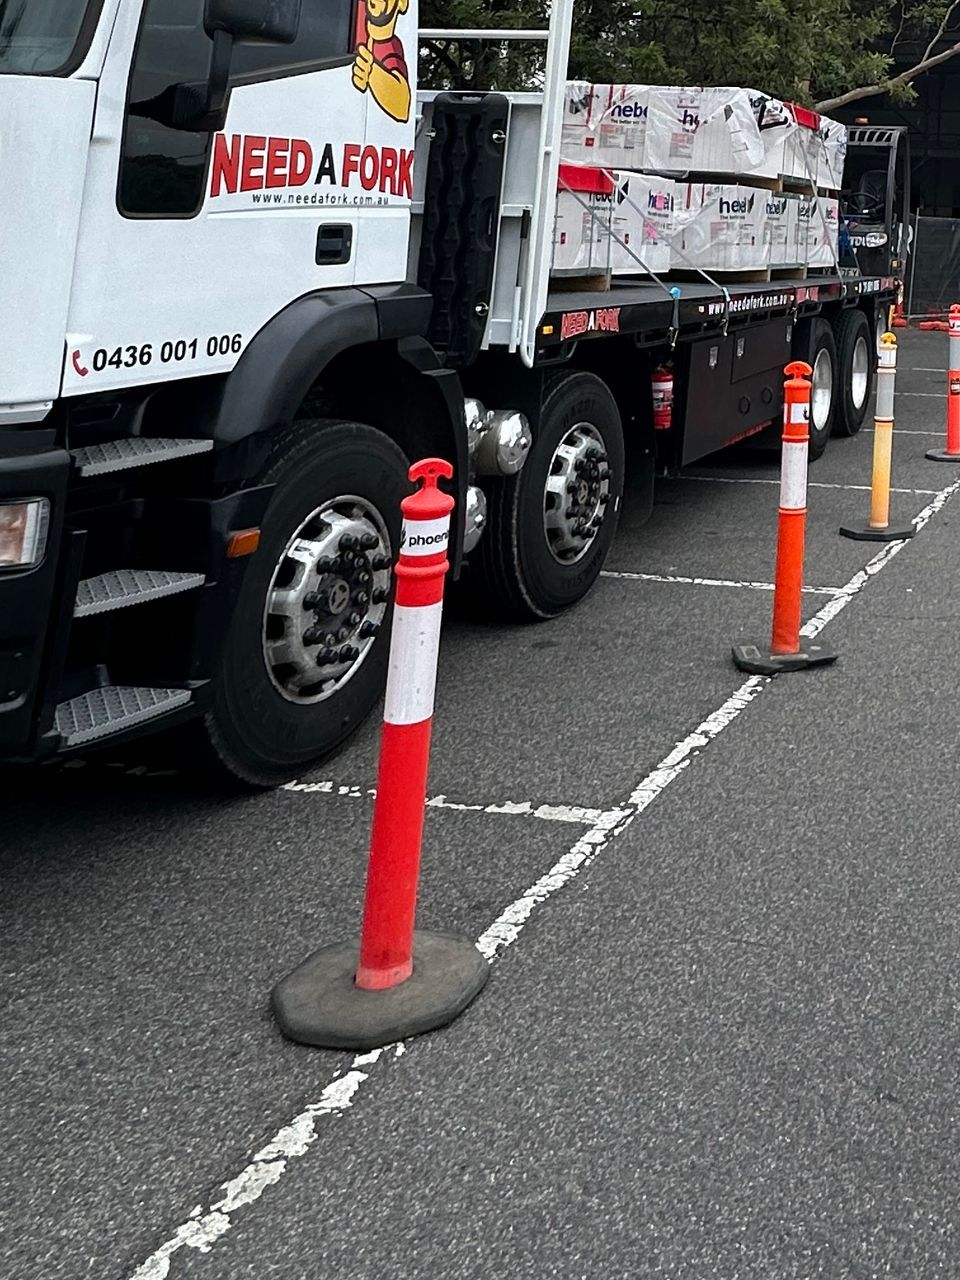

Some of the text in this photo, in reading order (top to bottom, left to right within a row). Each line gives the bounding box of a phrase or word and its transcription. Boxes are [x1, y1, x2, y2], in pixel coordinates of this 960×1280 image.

[210, 133, 415, 199] NEED A FORK
[252, 192, 389, 205] www.needafork.com.au
[561, 308, 620, 340] NEED A FORK
[92, 333, 243, 371] 0436 001 006
